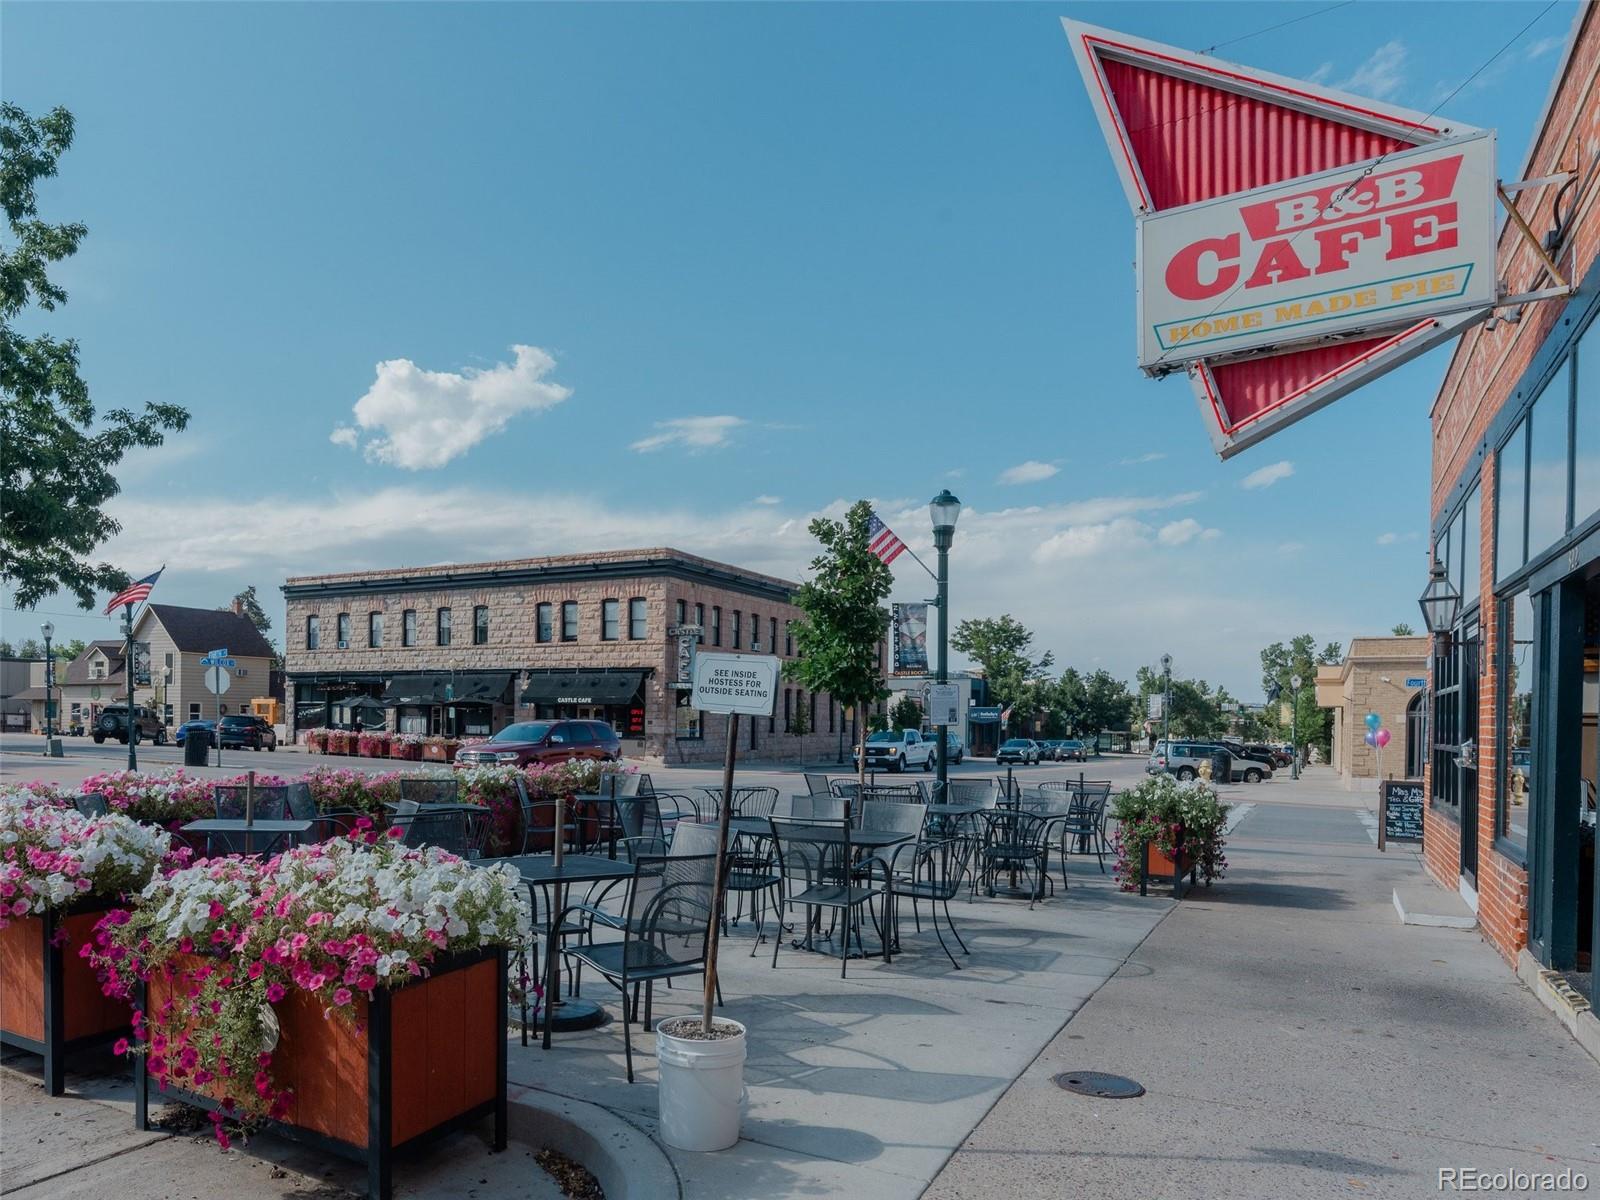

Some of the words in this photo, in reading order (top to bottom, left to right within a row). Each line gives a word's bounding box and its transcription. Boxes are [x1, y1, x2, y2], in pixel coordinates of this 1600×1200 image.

[1275, 170, 1424, 232] B&B
[1165, 201, 1458, 301] CAFE
[1169, 311, 1262, 343] HOME
[1276, 288, 1377, 321] MADE
[1391, 272, 1455, 298] PIE
[680, 638, 690, 680] CAFE
[714, 669, 729, 677] SEE
[731, 670, 757, 679] INSIDE
[699, 686, 733, 695] OUTSIDE
[734, 688, 768, 698] SEATING
[708, 678, 743, 687] HOSTESS
[745, 680, 761, 688] FOR
